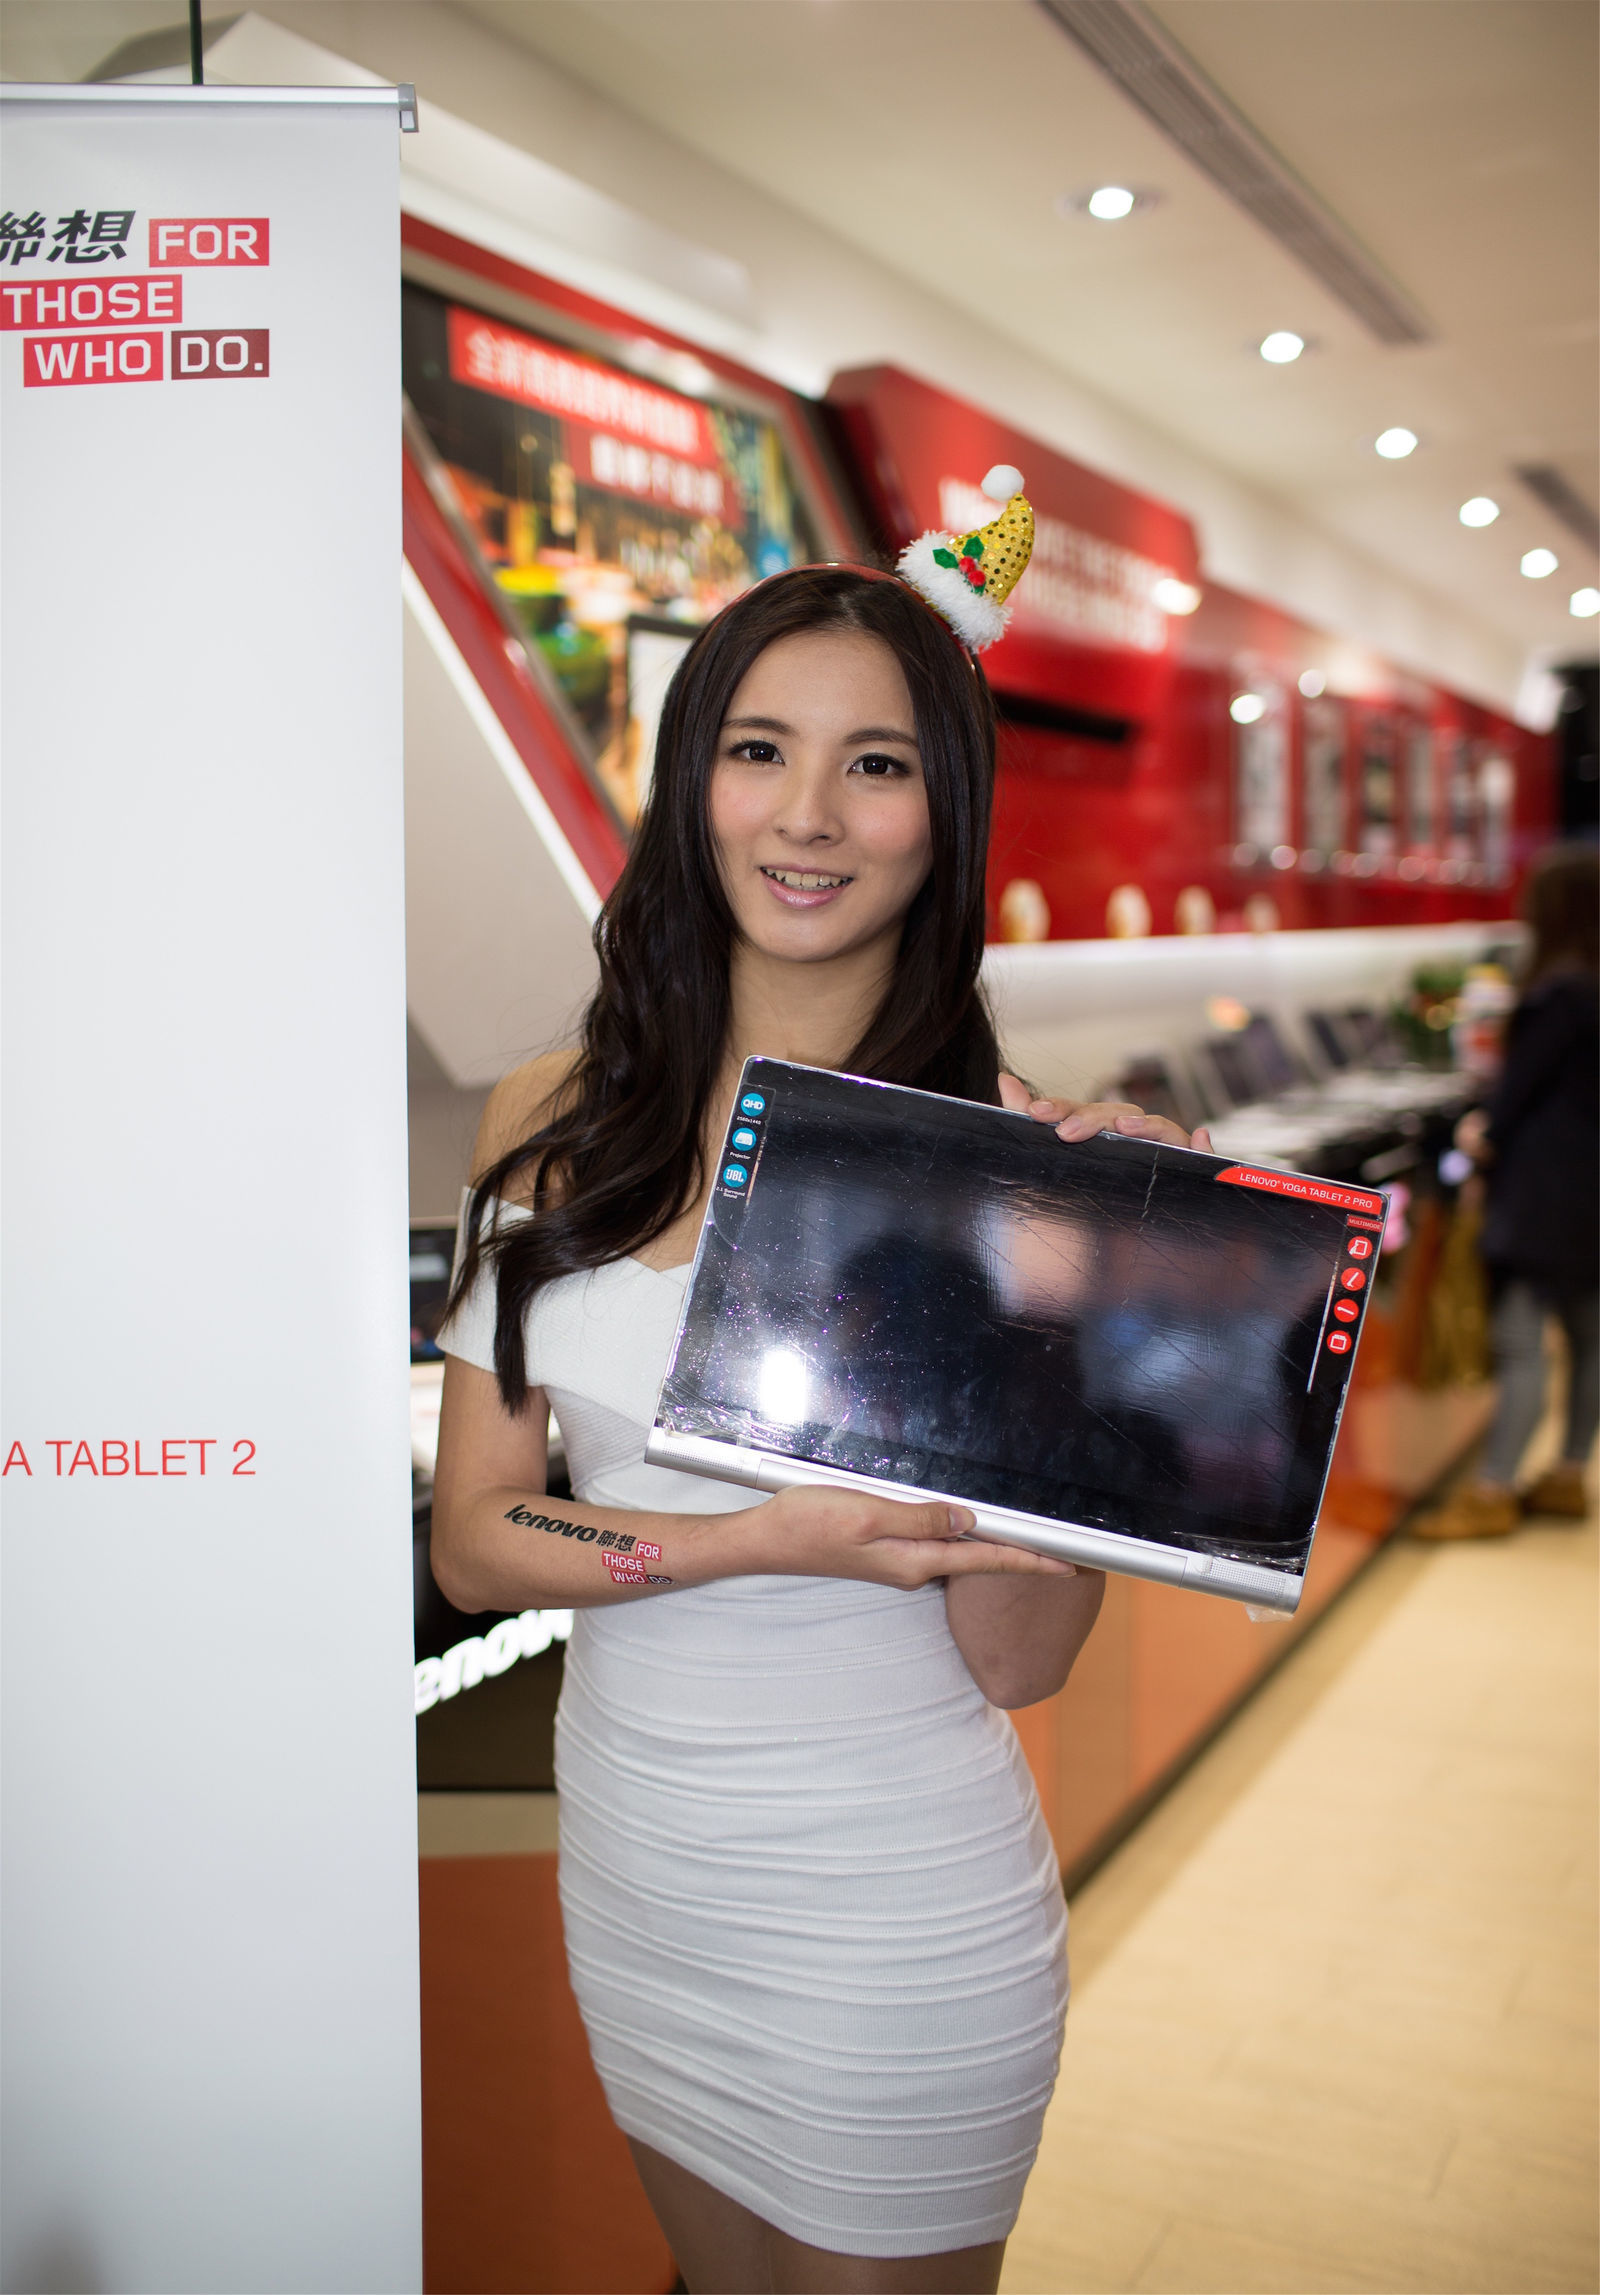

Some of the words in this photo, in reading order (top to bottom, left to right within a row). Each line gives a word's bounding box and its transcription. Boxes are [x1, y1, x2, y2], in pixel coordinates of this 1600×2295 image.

[158, 224, 260, 261] FOR
[2, 281, 174, 324] THOSE
[34, 339, 151, 380] WHO
[180, 335, 263, 373] DO.
[743, 1099, 763, 1110] QHD
[729, 1152, 751, 1160] Projector
[1281, 1181, 1307, 1194] YOGA
[1309, 1187, 1343, 1203] TABLET
[1343, 1195, 1351, 1204] 2
[1352, 1197, 1373, 1209] PRO
[1349, 1218, 1381, 1230] MULTIMODE
[2, 1440, 33, 1476] A
[45, 1439, 217, 1476] TABLET
[232, 1439, 256, 1475] 2
[504, 1503, 599, 1543] lenovo
[597, 1529, 637, 1552] 聯想
[637, 1543, 660, 1560] FOR
[603, 1552, 644, 1572] THOSE
[612, 1570, 646, 1584] WHO
